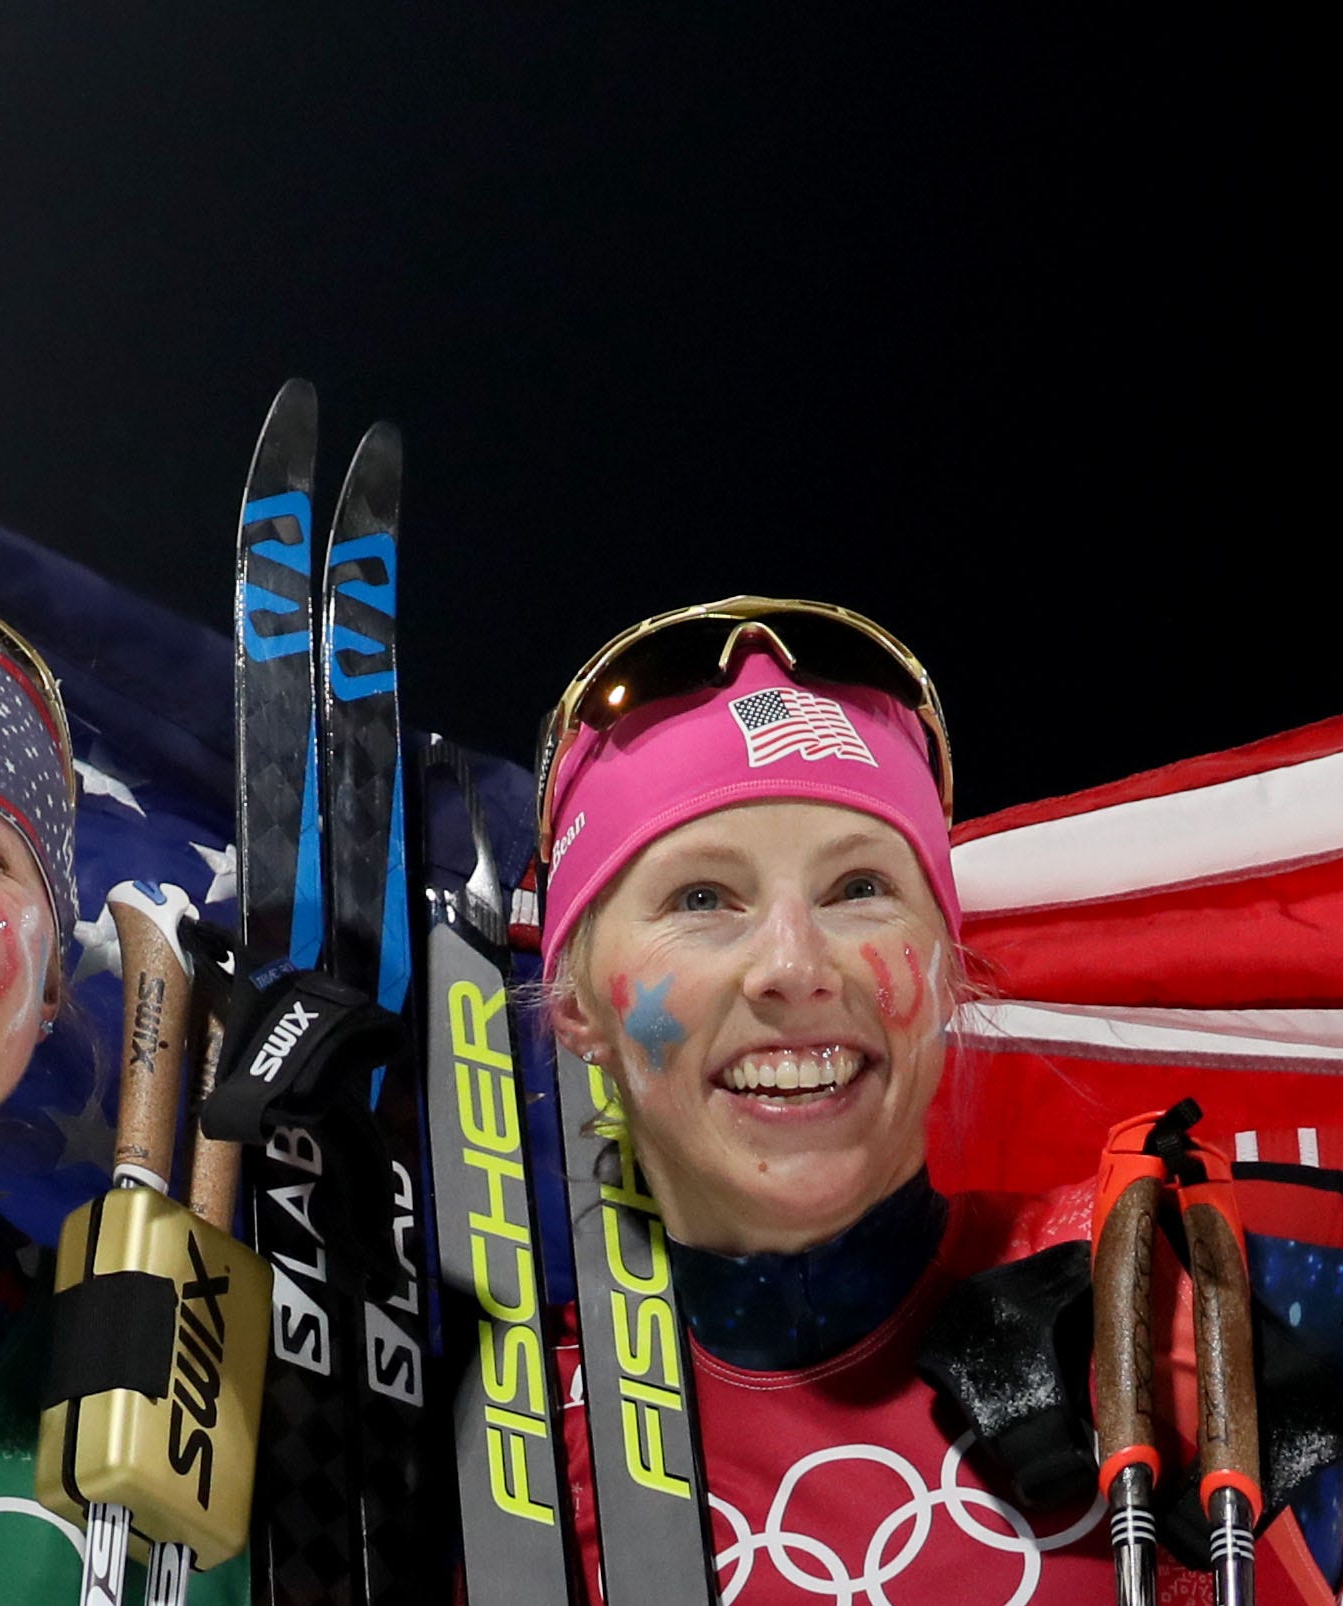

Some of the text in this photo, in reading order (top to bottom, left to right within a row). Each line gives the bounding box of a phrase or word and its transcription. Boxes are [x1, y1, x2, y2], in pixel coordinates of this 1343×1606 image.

[547, 811, 586, 890] Bean
[249, 1001, 319, 1083] SWIX
[167, 1229, 231, 1513] SWIX
[448, 979, 556, 1526] FISCHER
[587, 1063, 692, 1500] FISCH
